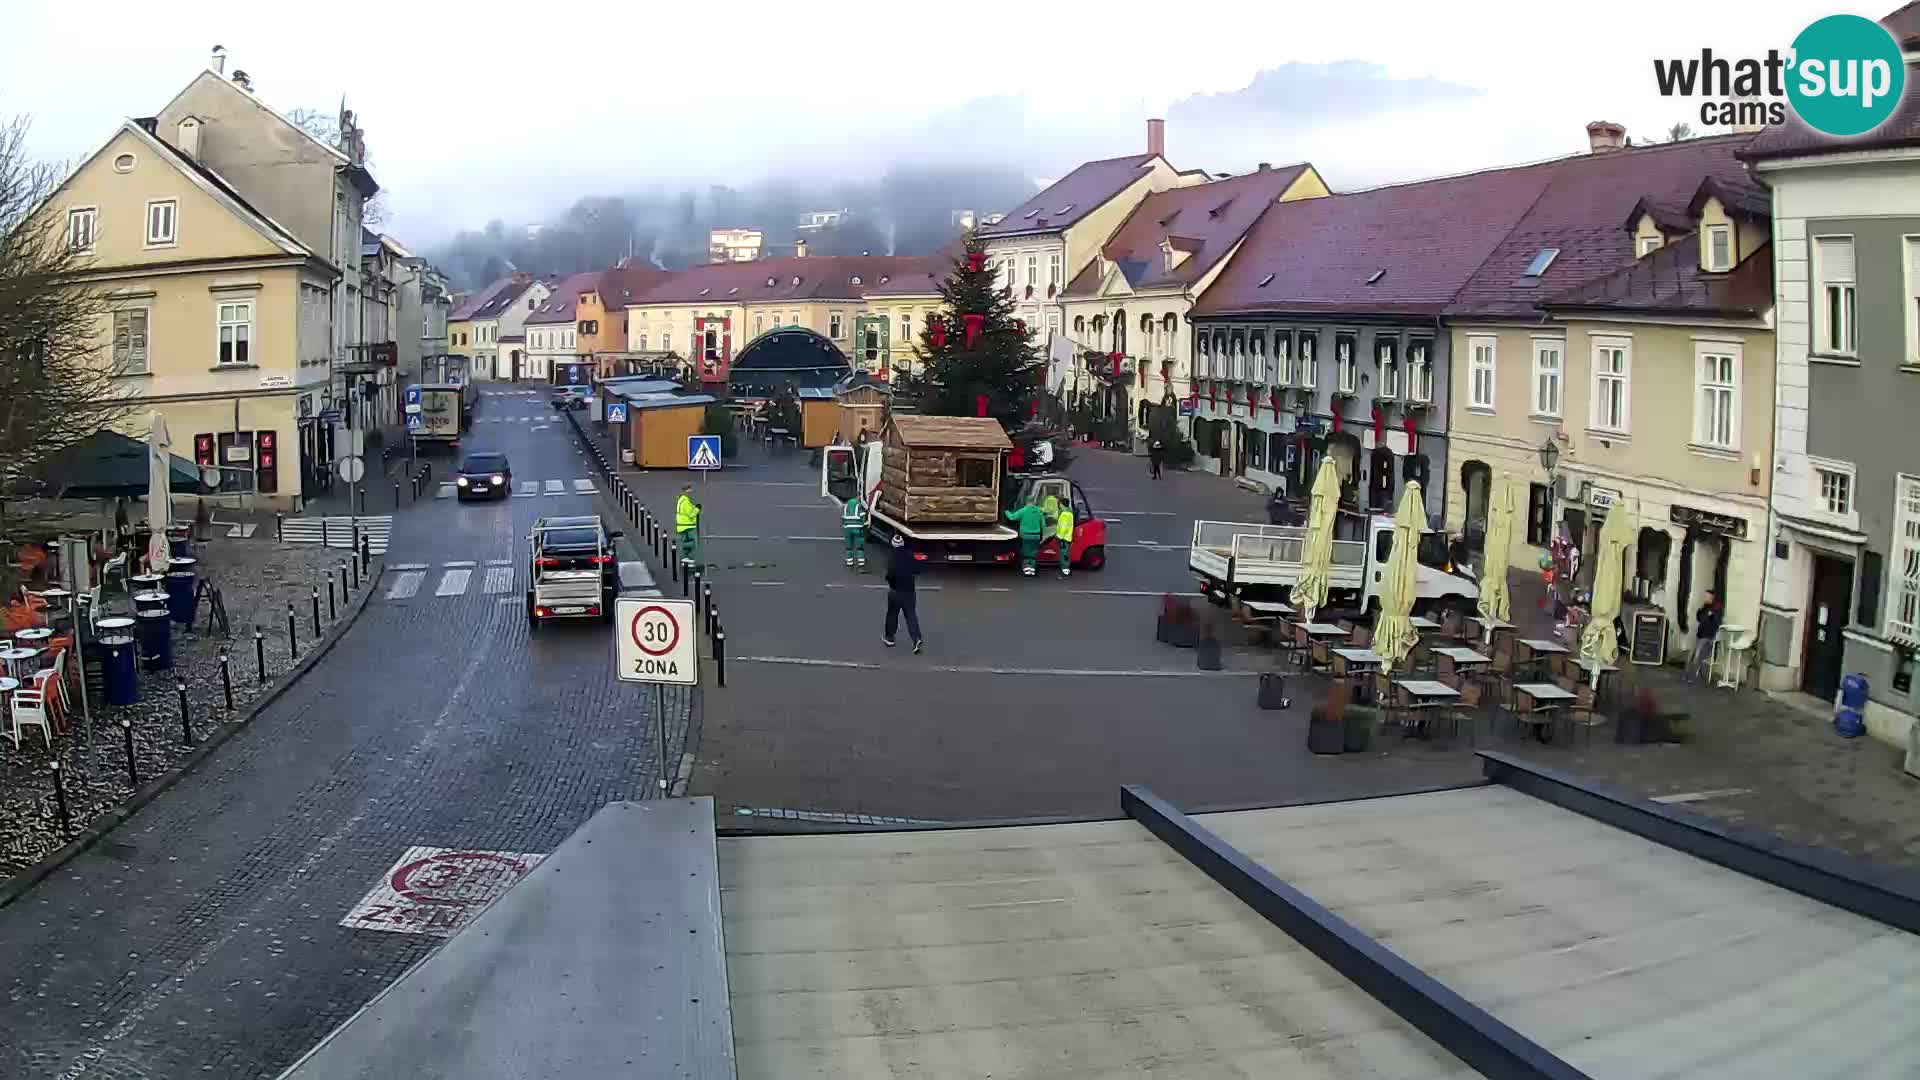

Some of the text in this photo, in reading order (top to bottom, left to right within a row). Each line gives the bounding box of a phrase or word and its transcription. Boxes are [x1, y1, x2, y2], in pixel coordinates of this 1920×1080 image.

[409, 391, 417, 402] P
[644, 621, 668, 643] 30
[634, 658, 679, 675] ZONA
